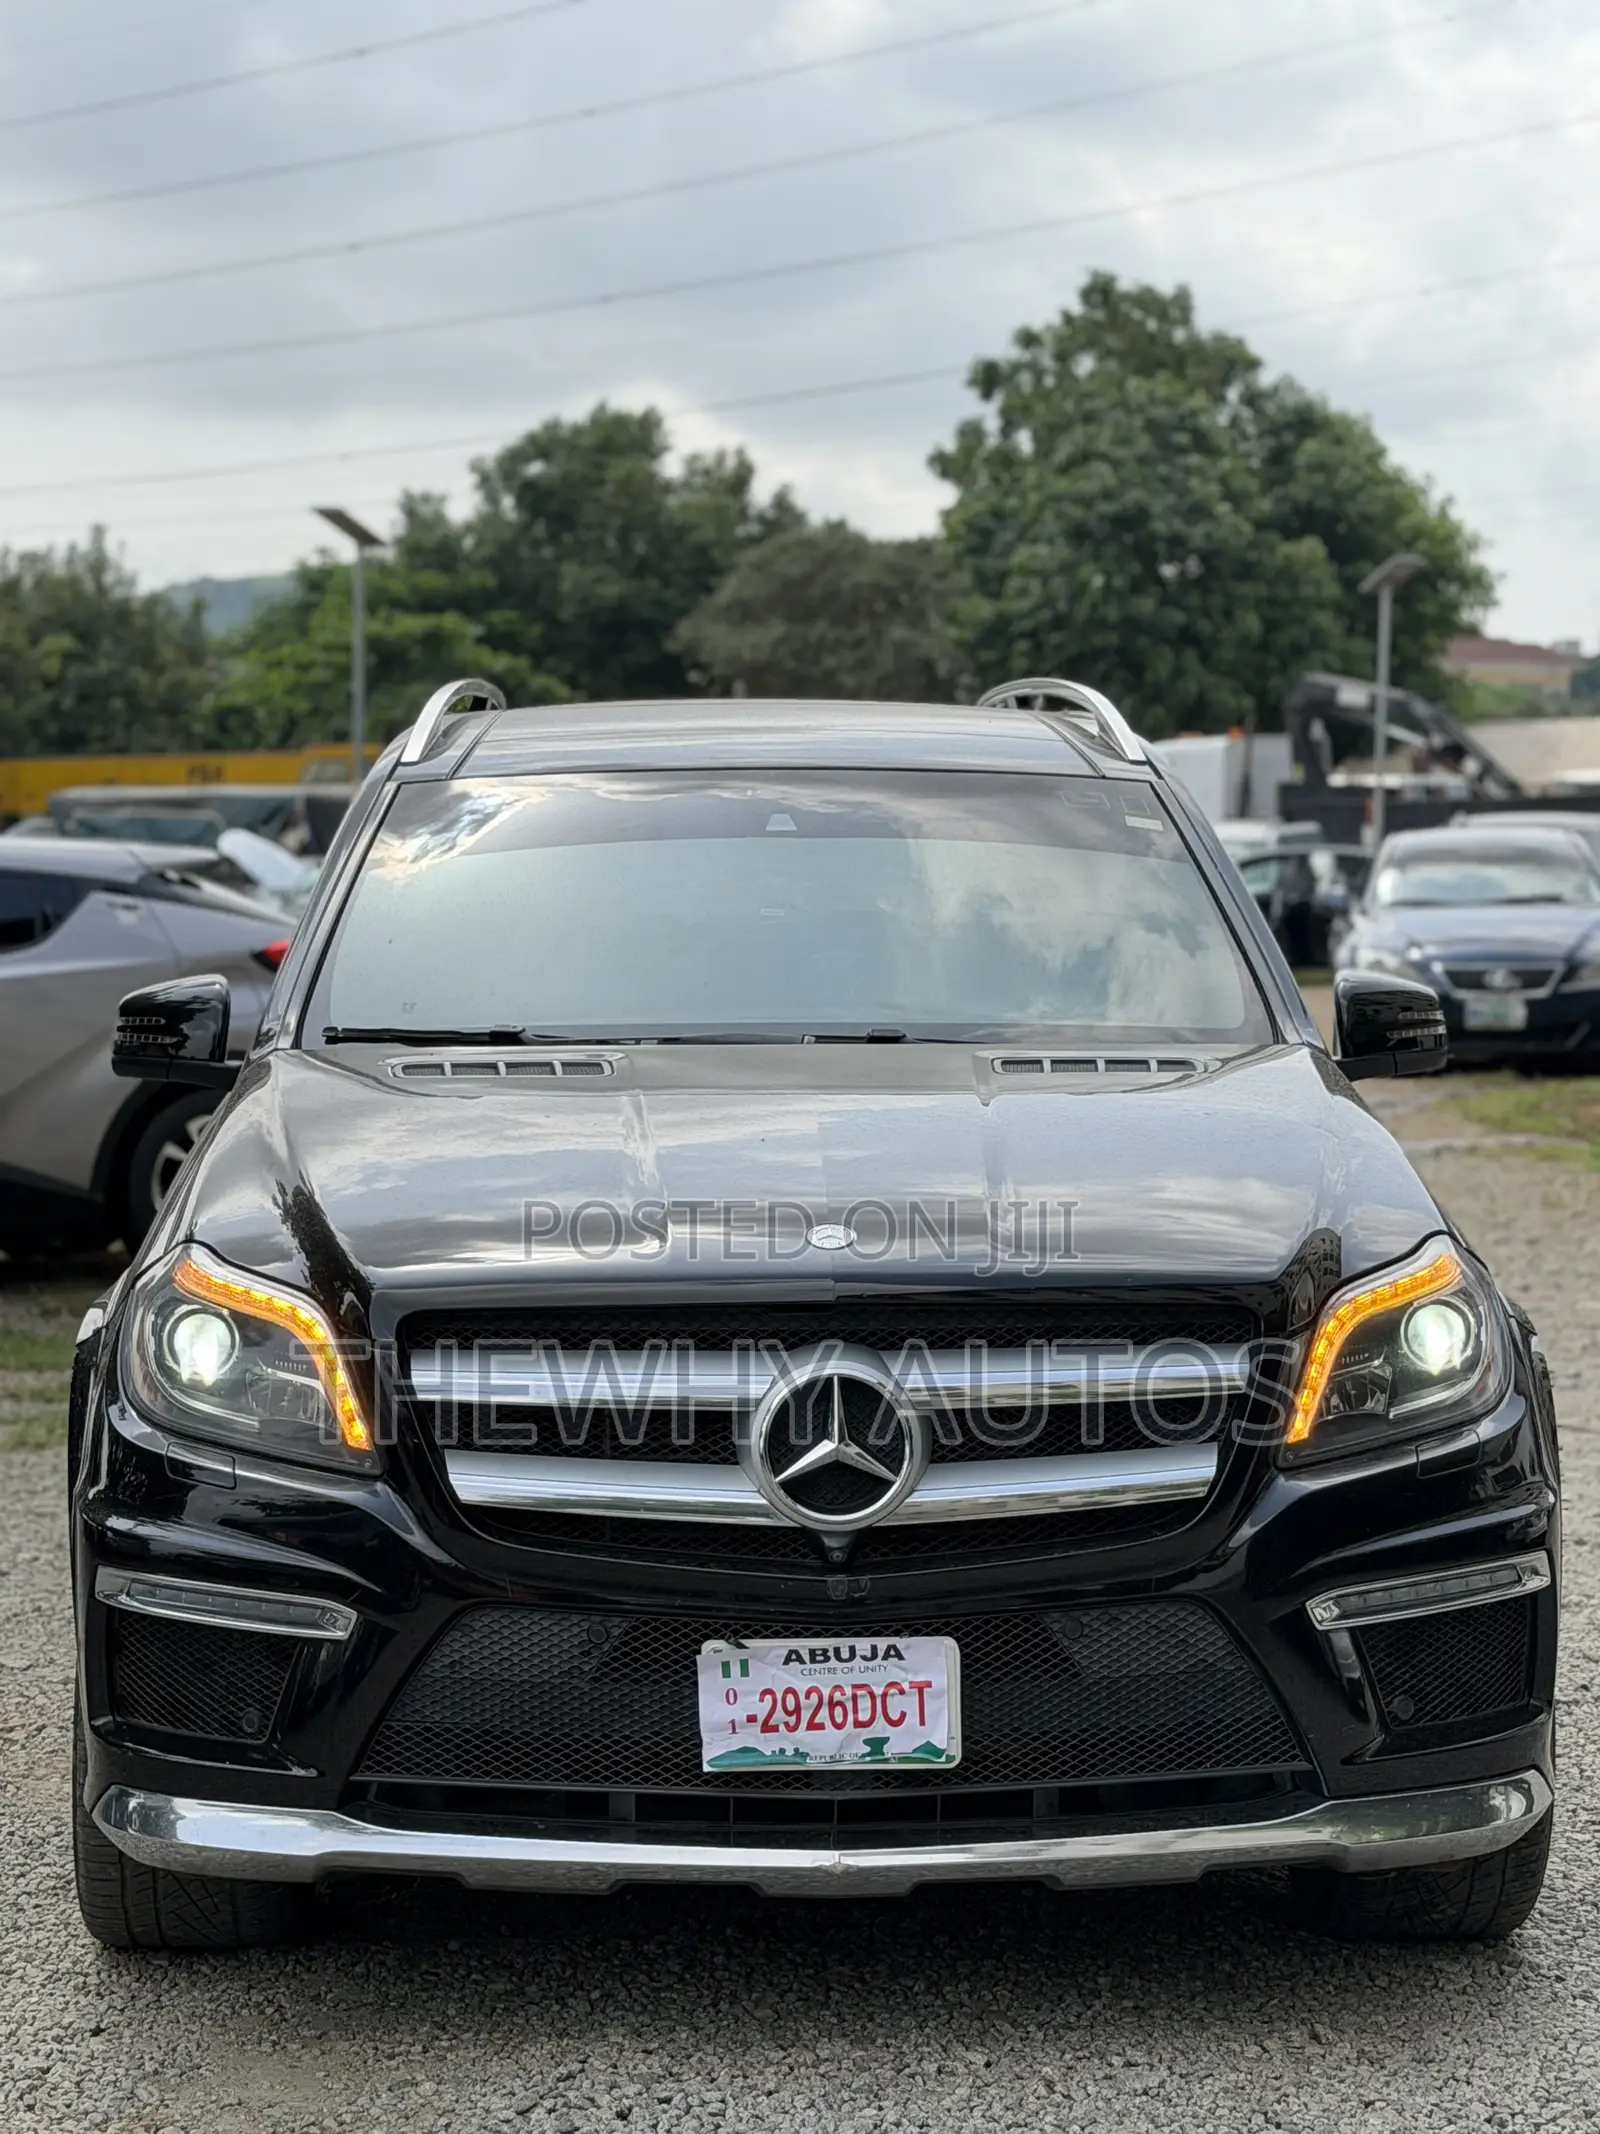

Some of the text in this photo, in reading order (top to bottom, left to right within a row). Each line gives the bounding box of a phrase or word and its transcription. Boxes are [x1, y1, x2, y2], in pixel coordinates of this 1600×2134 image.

[782, 1643, 906, 1666] ABUJA
[800, 1664, 888, 1677] CENTRE OF UNITY
